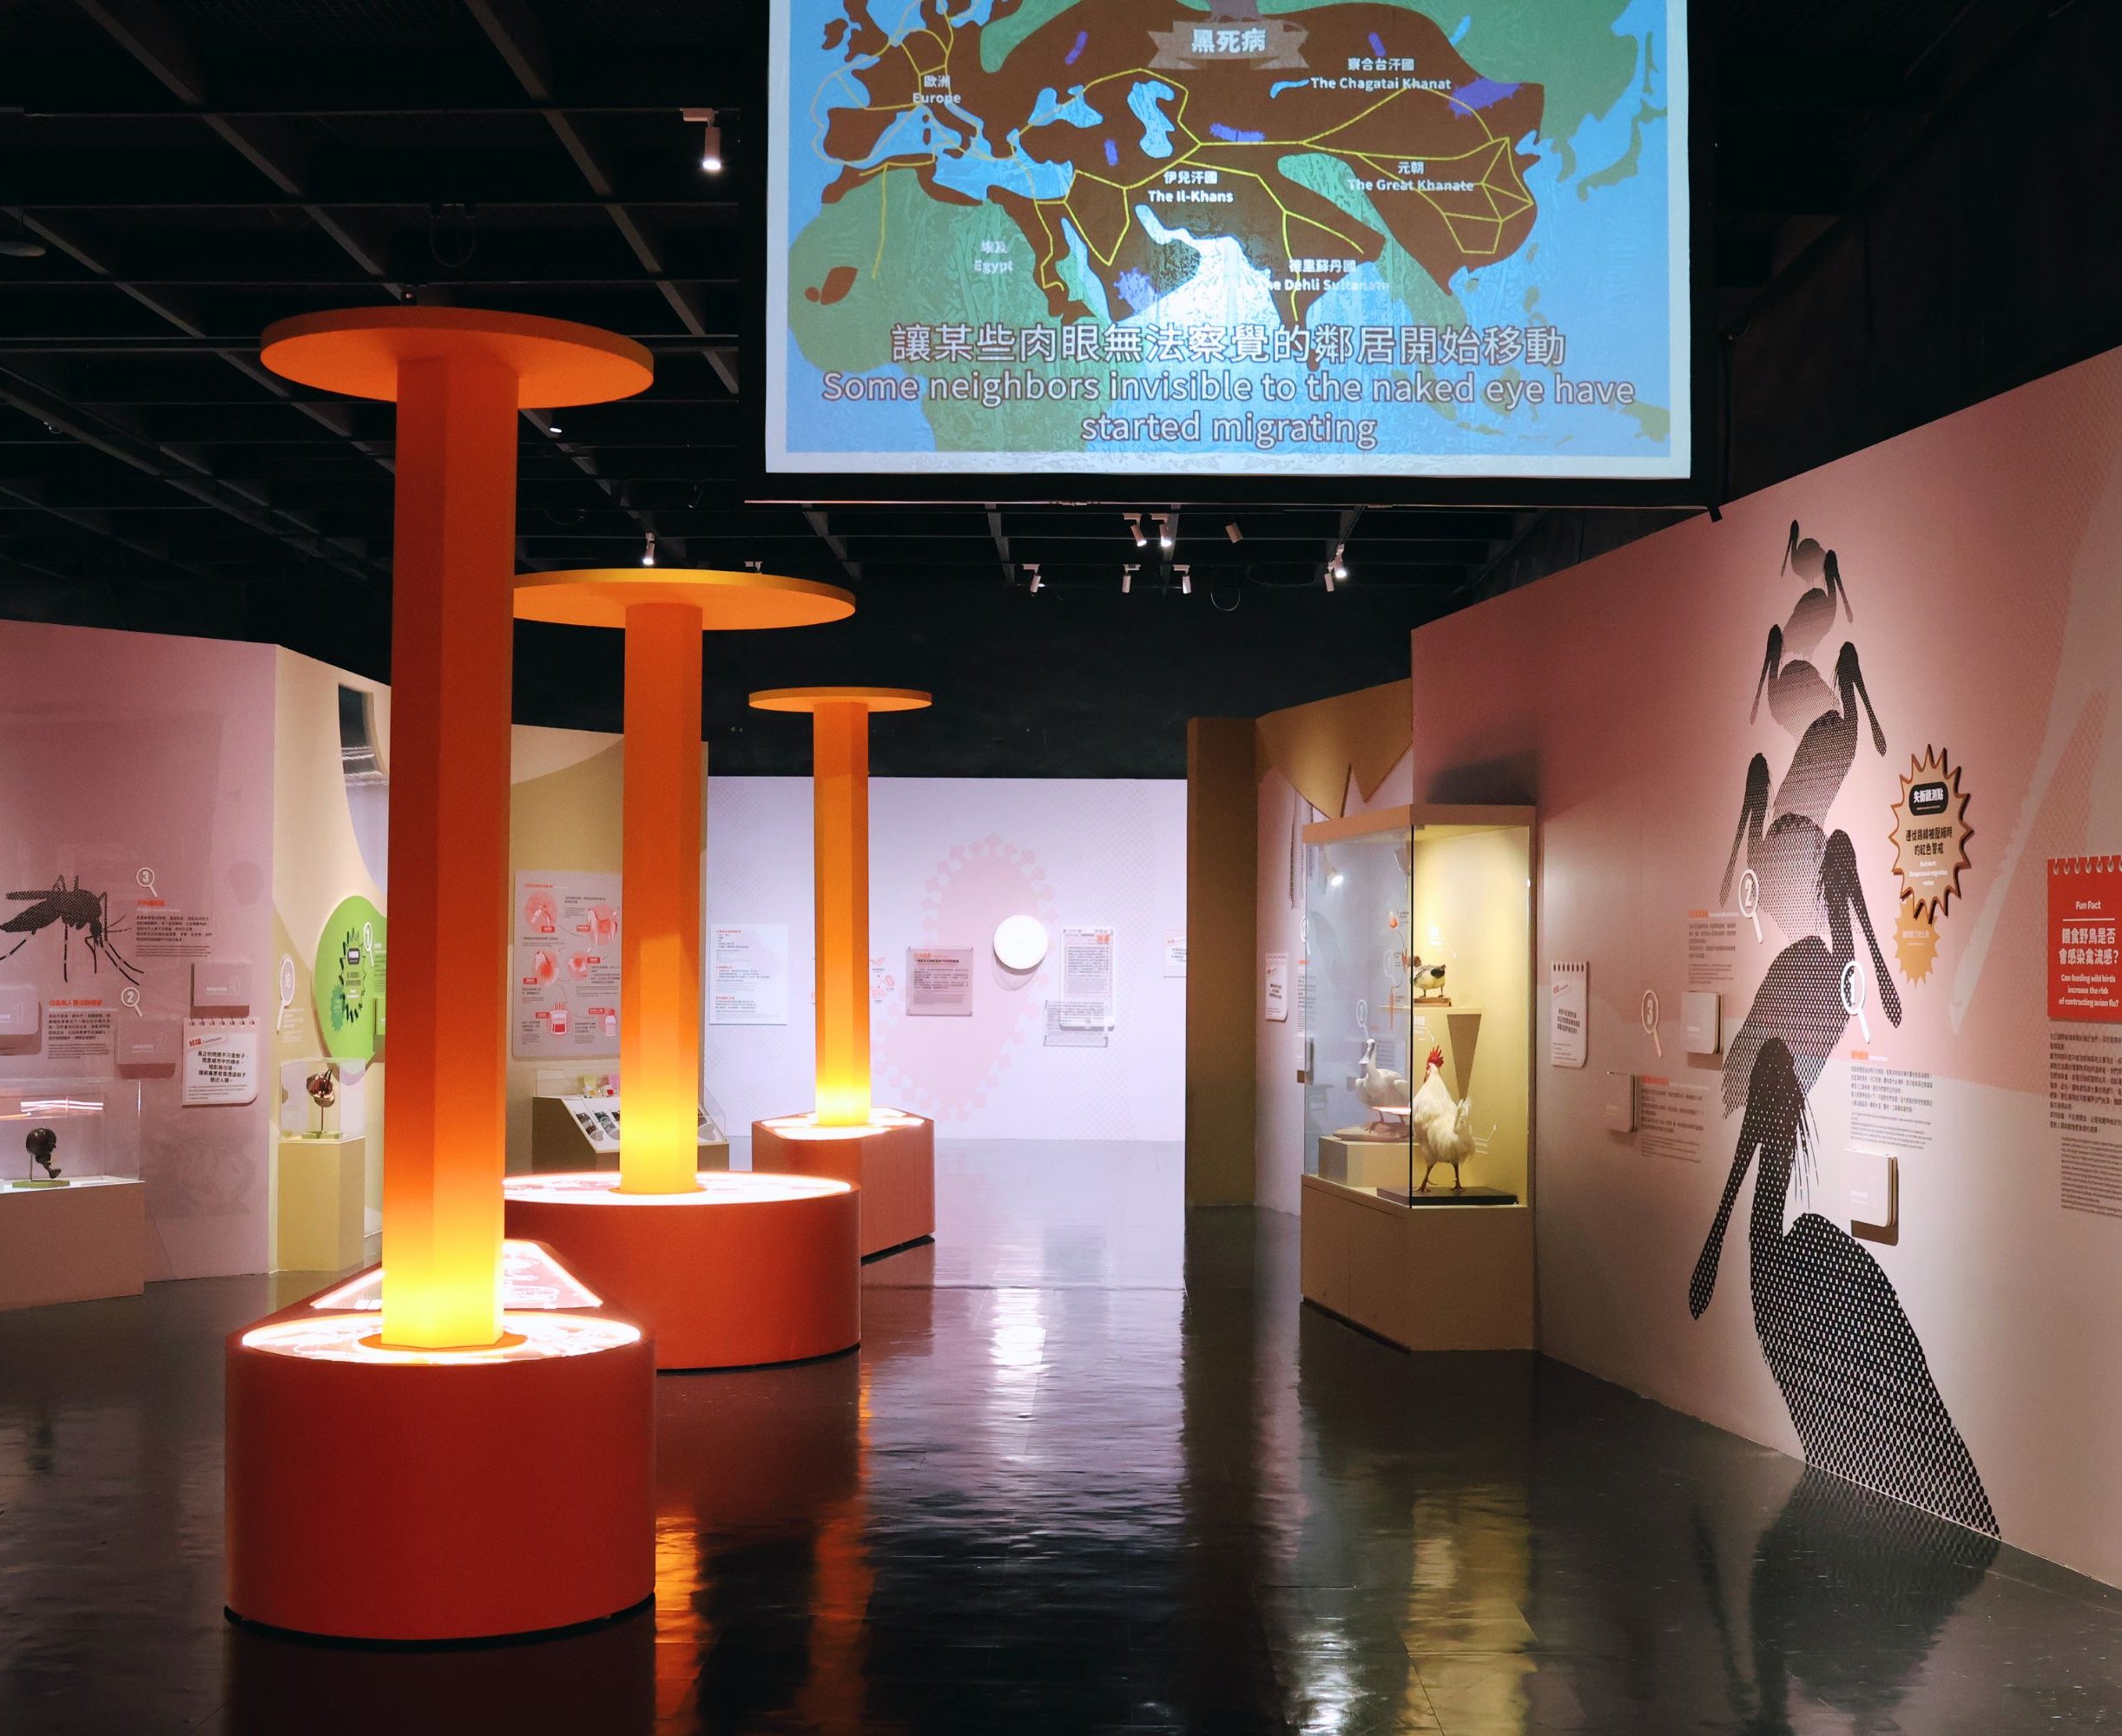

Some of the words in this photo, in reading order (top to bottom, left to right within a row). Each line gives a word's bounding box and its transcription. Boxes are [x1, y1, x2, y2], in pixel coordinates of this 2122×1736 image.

[1191, 28, 1266, 53] 黑死病
[924, 75, 950, 88] 歐洲
[1311, 77, 1336, 89] The
[1340, 77, 1399, 91] Chagatai
[1402, 78, 1451, 90] Khanat
[913, 92, 961, 104] Europe
[1398, 161, 1425, 174] 元朝
[1163, 170, 1218, 184] 伊兒汗國
[1348, 179, 1374, 191] The
[1377, 179, 1414, 191] Great
[1418, 179, 1473, 192] Khanate
[1148, 190, 1174, 202] The
[1176, 190, 1234, 202] Il-Khans
[974, 260, 1013, 274] Egypt
[1285, 279, 1320, 291] Dehli
[890, 323, 1565, 365] 讓某些肉眼無法察覺的鄰居開始移動
[821, 372, 920, 402] Some
[928, 368, 1100, 408] neighbors
[1109, 369, 1253, 402] invisible
[1262, 376, 1297, 403] to
[1307, 369, 1362, 403] the
[1372, 370, 1475, 404] naked
[1485, 378, 1545, 411] eye
[1554, 373, 1636, 405] have
[1081, 411, 1203, 443] started
[1213, 411, 1379, 450] migrating
[142, 871, 149, 883] 3
[1745, 878, 1752, 907] 2
[2076, 901, 2087, 910] Fun
[2087, 900, 2101, 910] Fact
[1849, 973, 1855, 1004] 1
[127, 991, 135, 1003] 2
